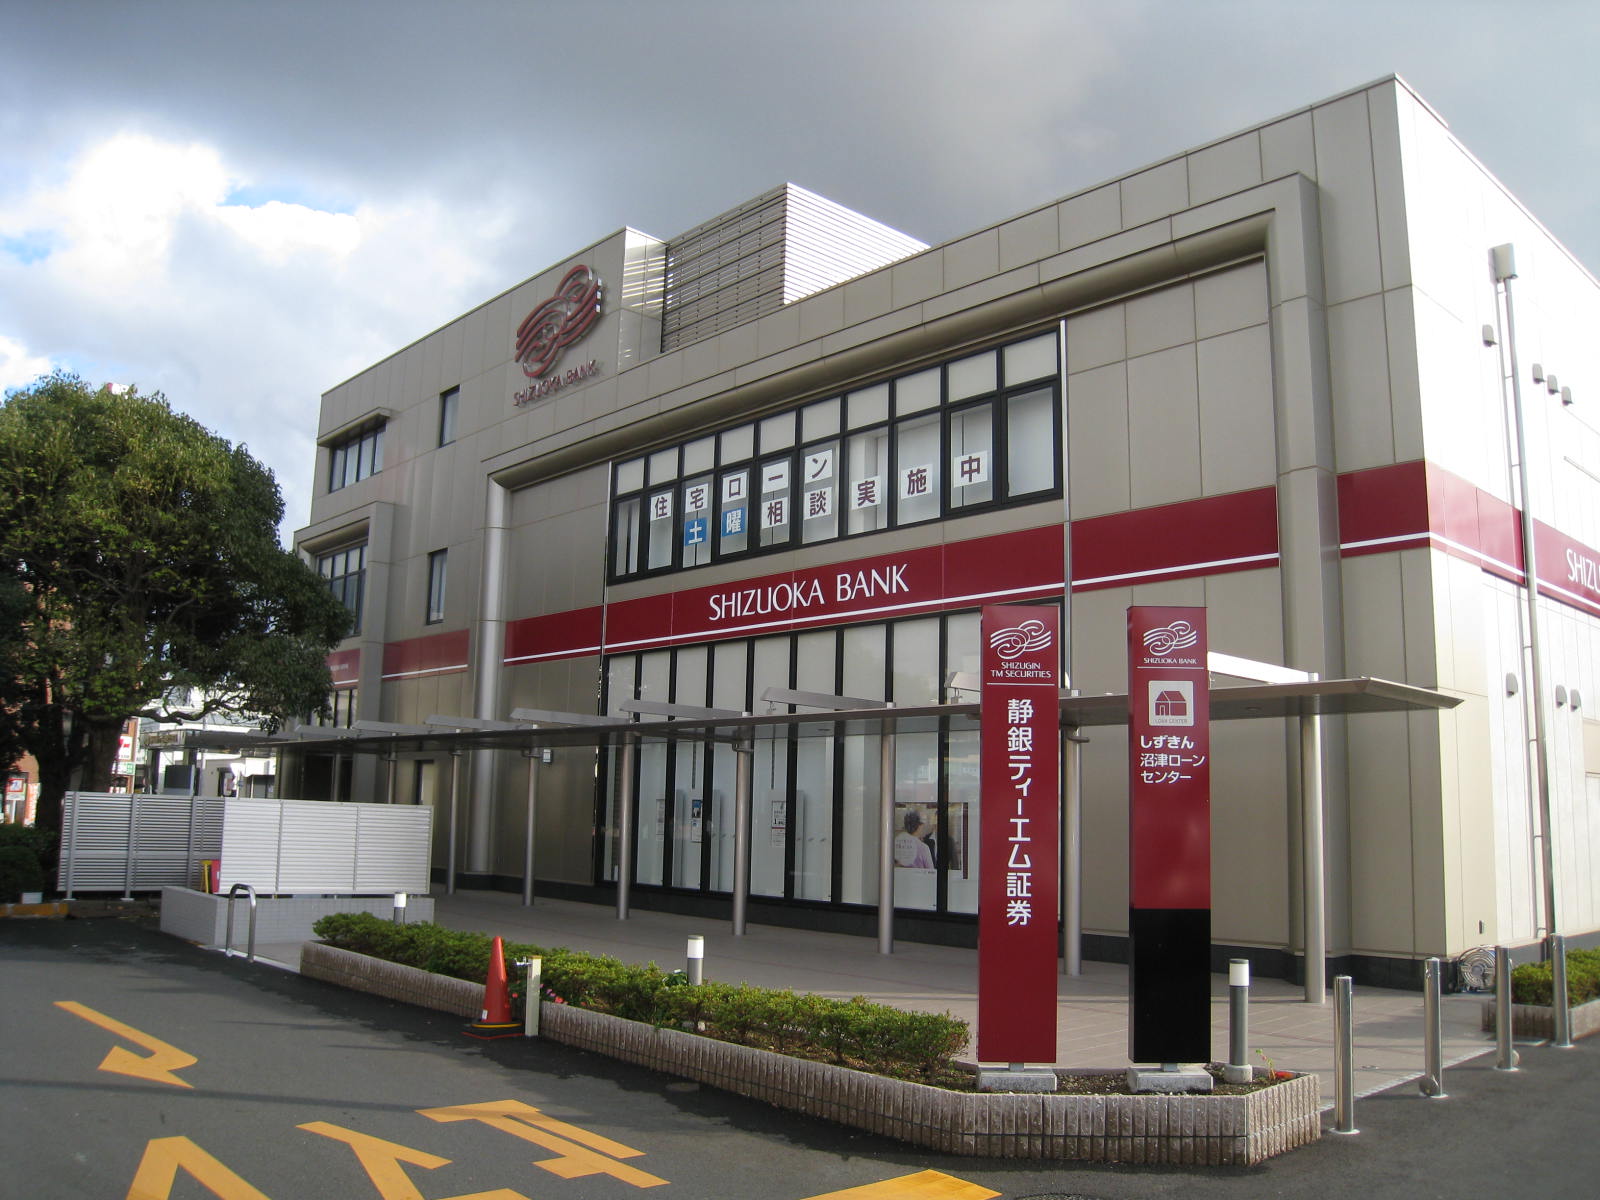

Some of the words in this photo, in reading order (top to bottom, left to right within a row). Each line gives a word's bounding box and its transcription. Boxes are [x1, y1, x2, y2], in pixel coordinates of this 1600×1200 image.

[513, 375, 563, 407] SHIZUOKA
[566, 359, 597, 385] BANK
[655, 456, 828, 517] 住宅ローン
[708, 579, 825, 621] SHIZUOKA
[836, 564, 909, 602] BANK
[1001, 661, 1041, 670] SHIZUGIN
[991, 669, 1003, 677] TM
[1005, 670, 1052, 678] SECURITIES
[1140, 735, 1194, 749] しずきん
[1140, 753, 1205, 767] 沼津ローン
[1140, 770, 1192, 784] センター
[1006, 698, 1034, 926] 静銀ティーエム証券
